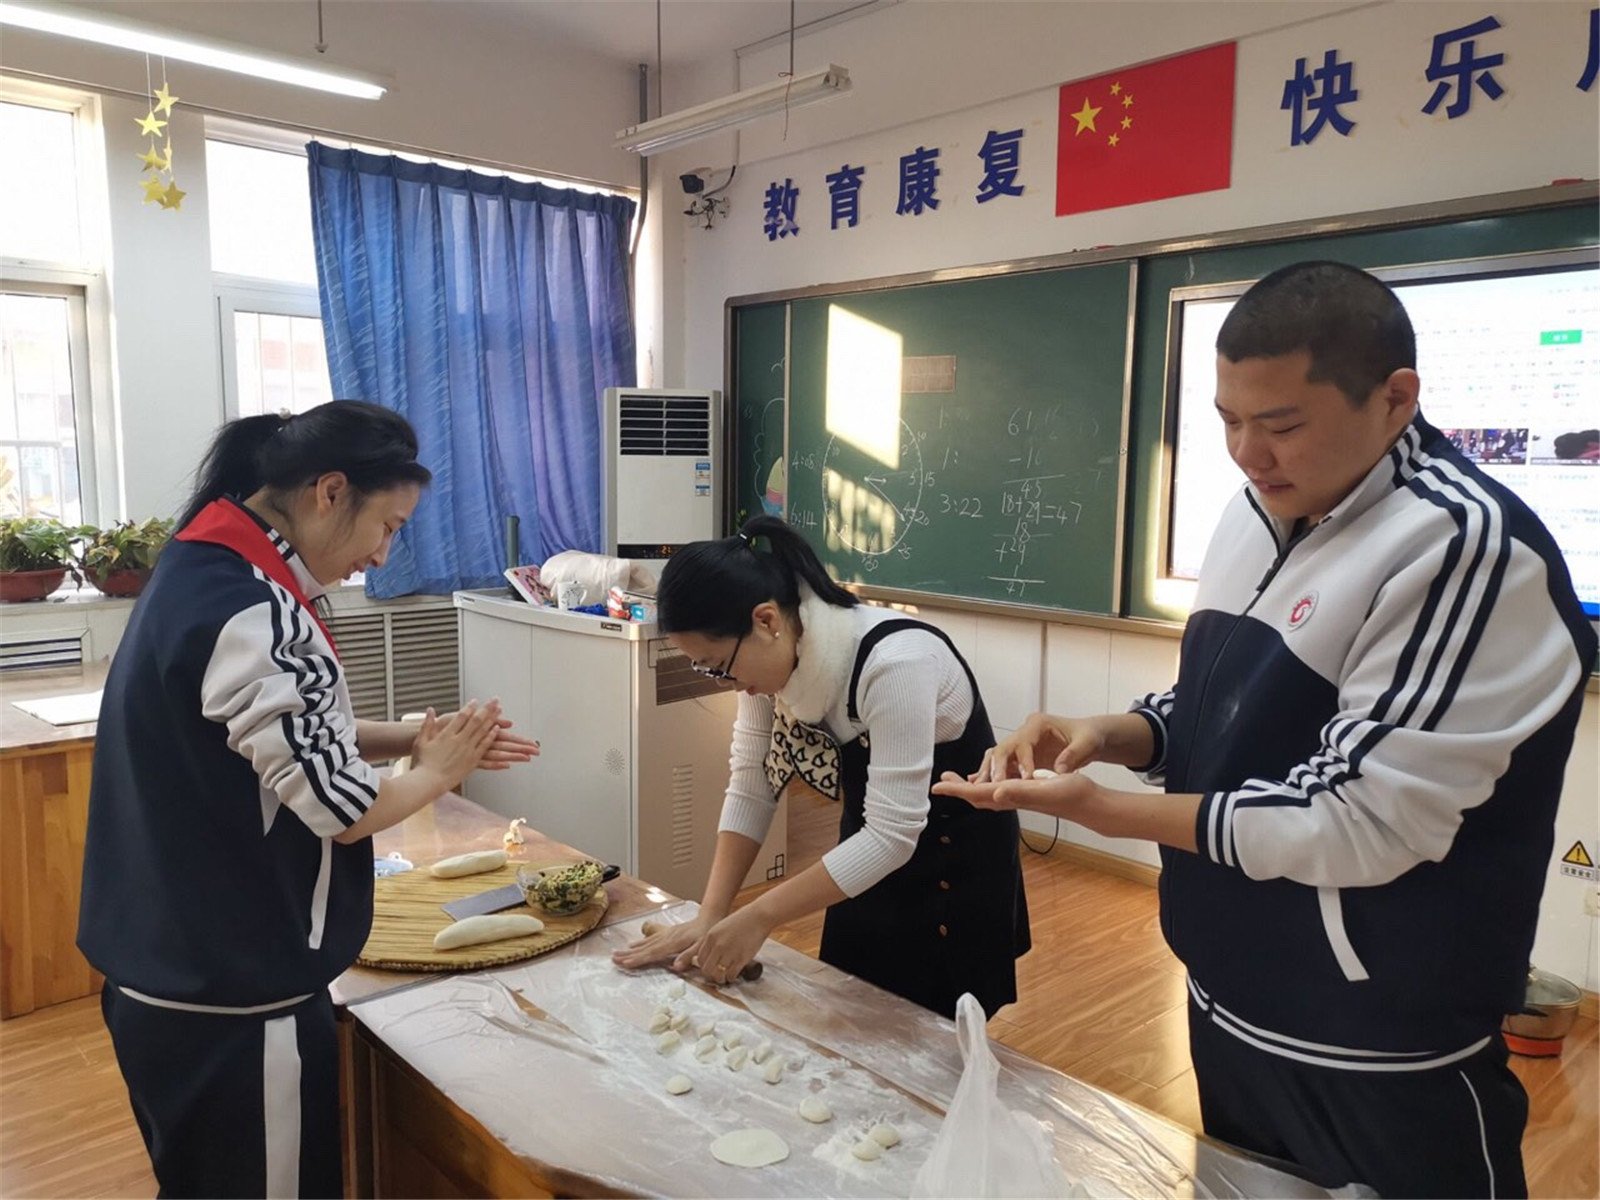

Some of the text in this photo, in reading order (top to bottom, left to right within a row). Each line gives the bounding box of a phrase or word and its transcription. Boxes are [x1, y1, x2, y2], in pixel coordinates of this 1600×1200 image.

[763, 128, 1025, 242] 教育康复
[940, 493, 984, 519] 3:22
